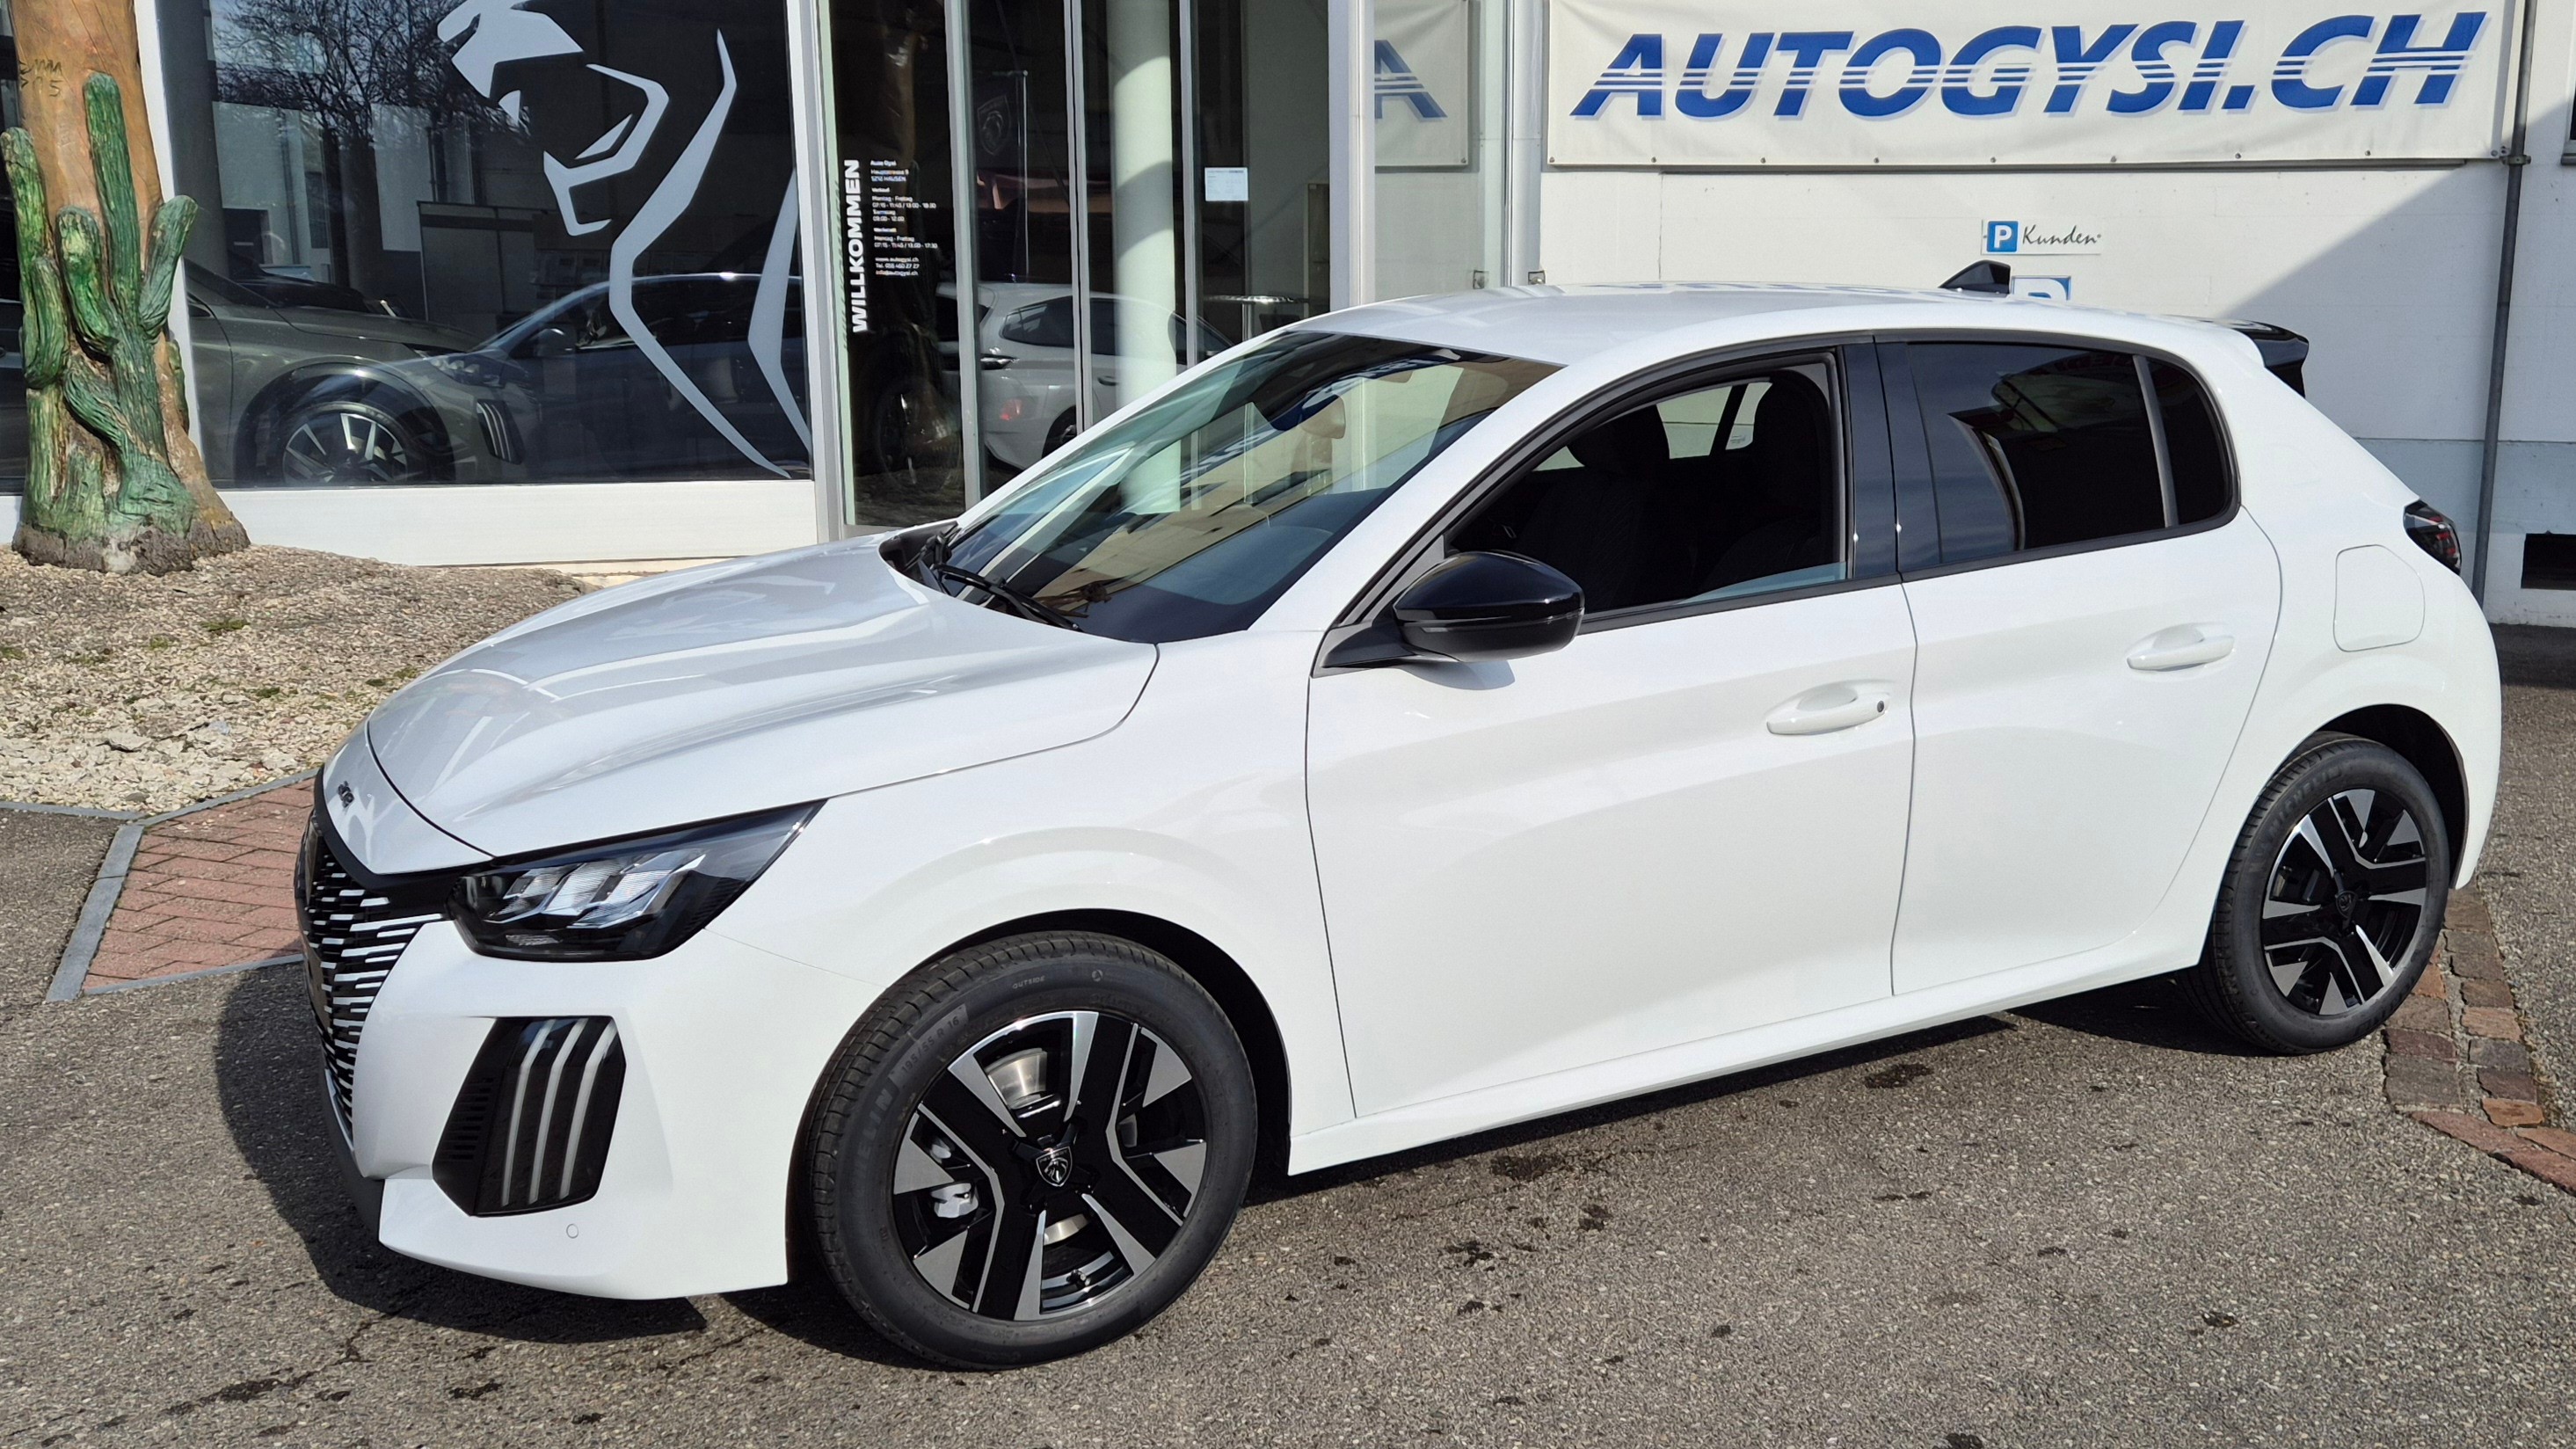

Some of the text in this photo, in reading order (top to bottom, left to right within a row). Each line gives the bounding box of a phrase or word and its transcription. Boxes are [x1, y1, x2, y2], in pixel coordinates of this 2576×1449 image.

[1569, 11, 2488, 121] AUTOGYSI.CH
[844, 159, 868, 333] WILLKOMMEN
[2022, 223, 2098, 245] Kunden
[936, 1028, 945, 1038] R
[947, 1016, 959, 1029] 16
